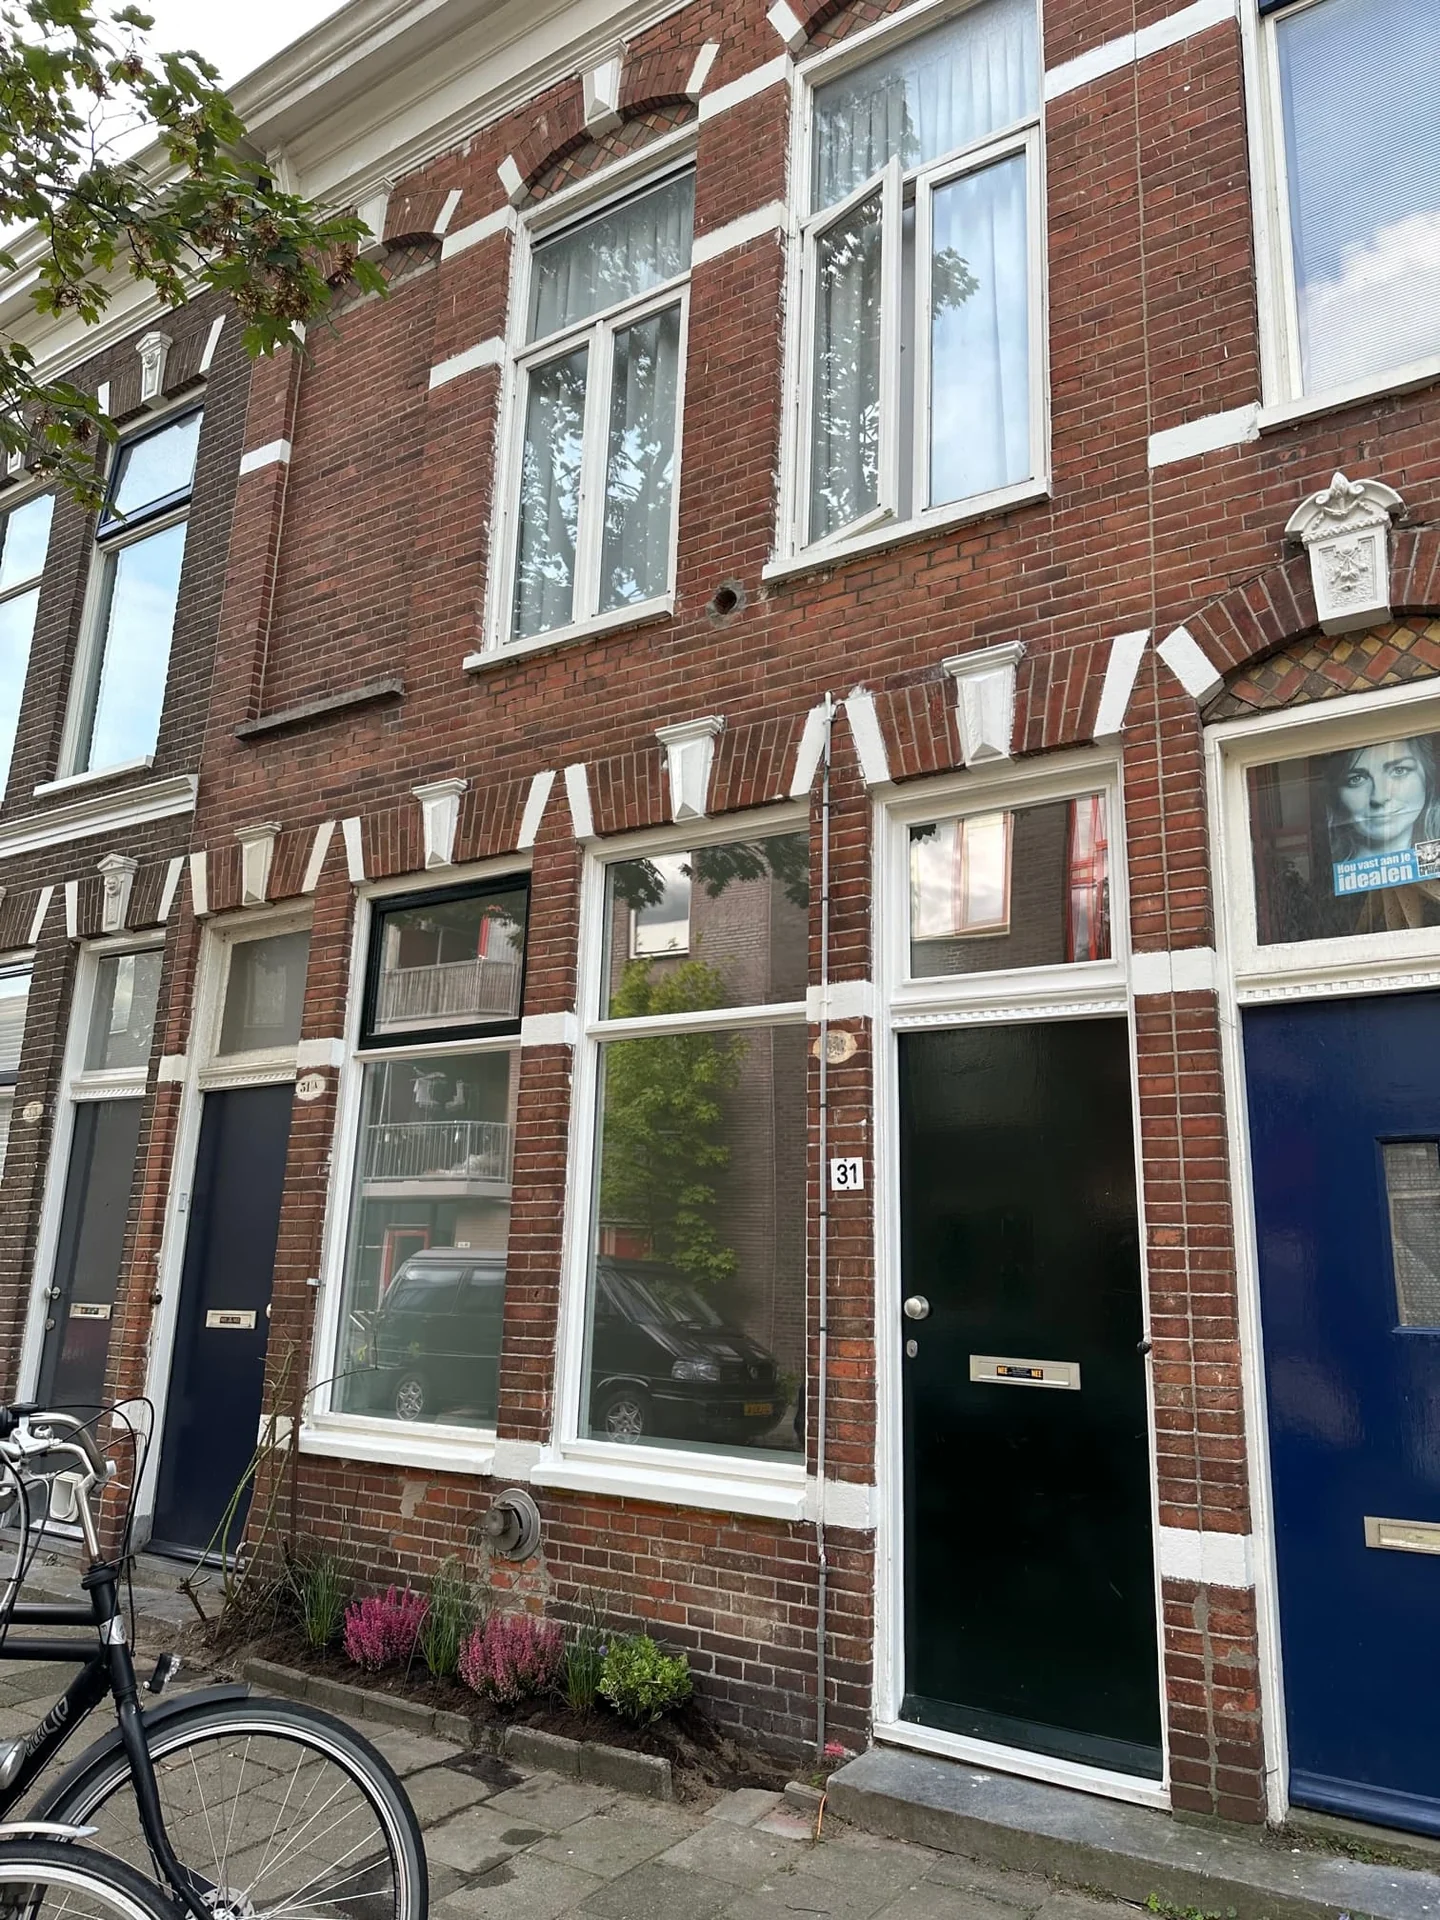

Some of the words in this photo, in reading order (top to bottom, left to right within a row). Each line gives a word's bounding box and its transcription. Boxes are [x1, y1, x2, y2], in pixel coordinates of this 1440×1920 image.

[1337, 863, 1356, 874] Hou
[1357, 858, 1379, 870] vast
[1380, 854, 1399, 866] aan
[1338, 865, 1413, 892] idealen
[836, 1163, 857, 1185] 31
